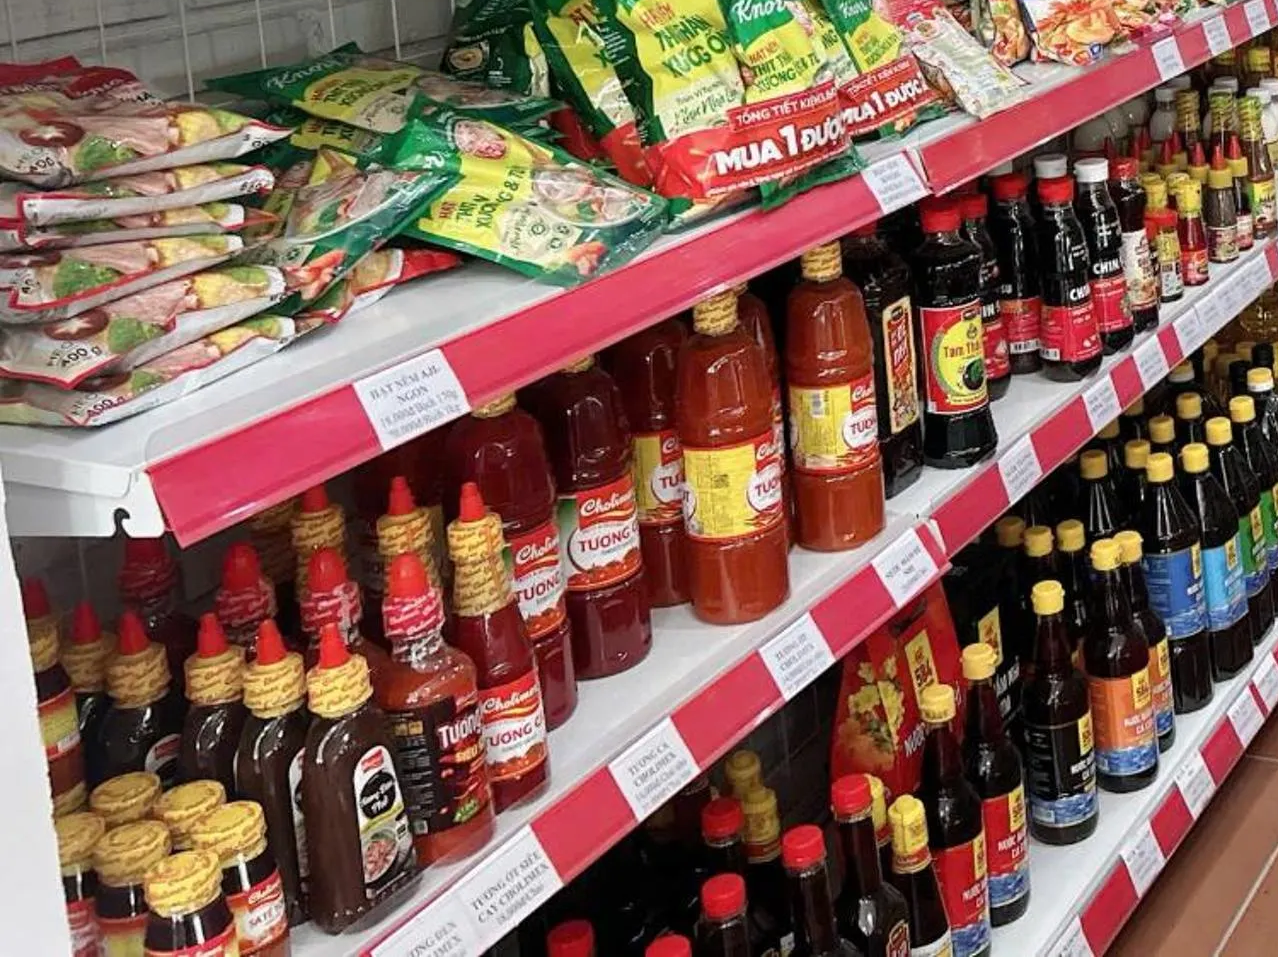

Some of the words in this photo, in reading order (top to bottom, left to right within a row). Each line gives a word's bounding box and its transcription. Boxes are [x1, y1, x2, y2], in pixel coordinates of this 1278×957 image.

[840, 101, 877, 126] MUA
[871, 91, 886, 115] 1
[714, 138, 783, 175] MUA
[779, 124, 800, 156] 1
[943, 345, 964, 359] Tam
[397, 384, 428, 406] NGON
